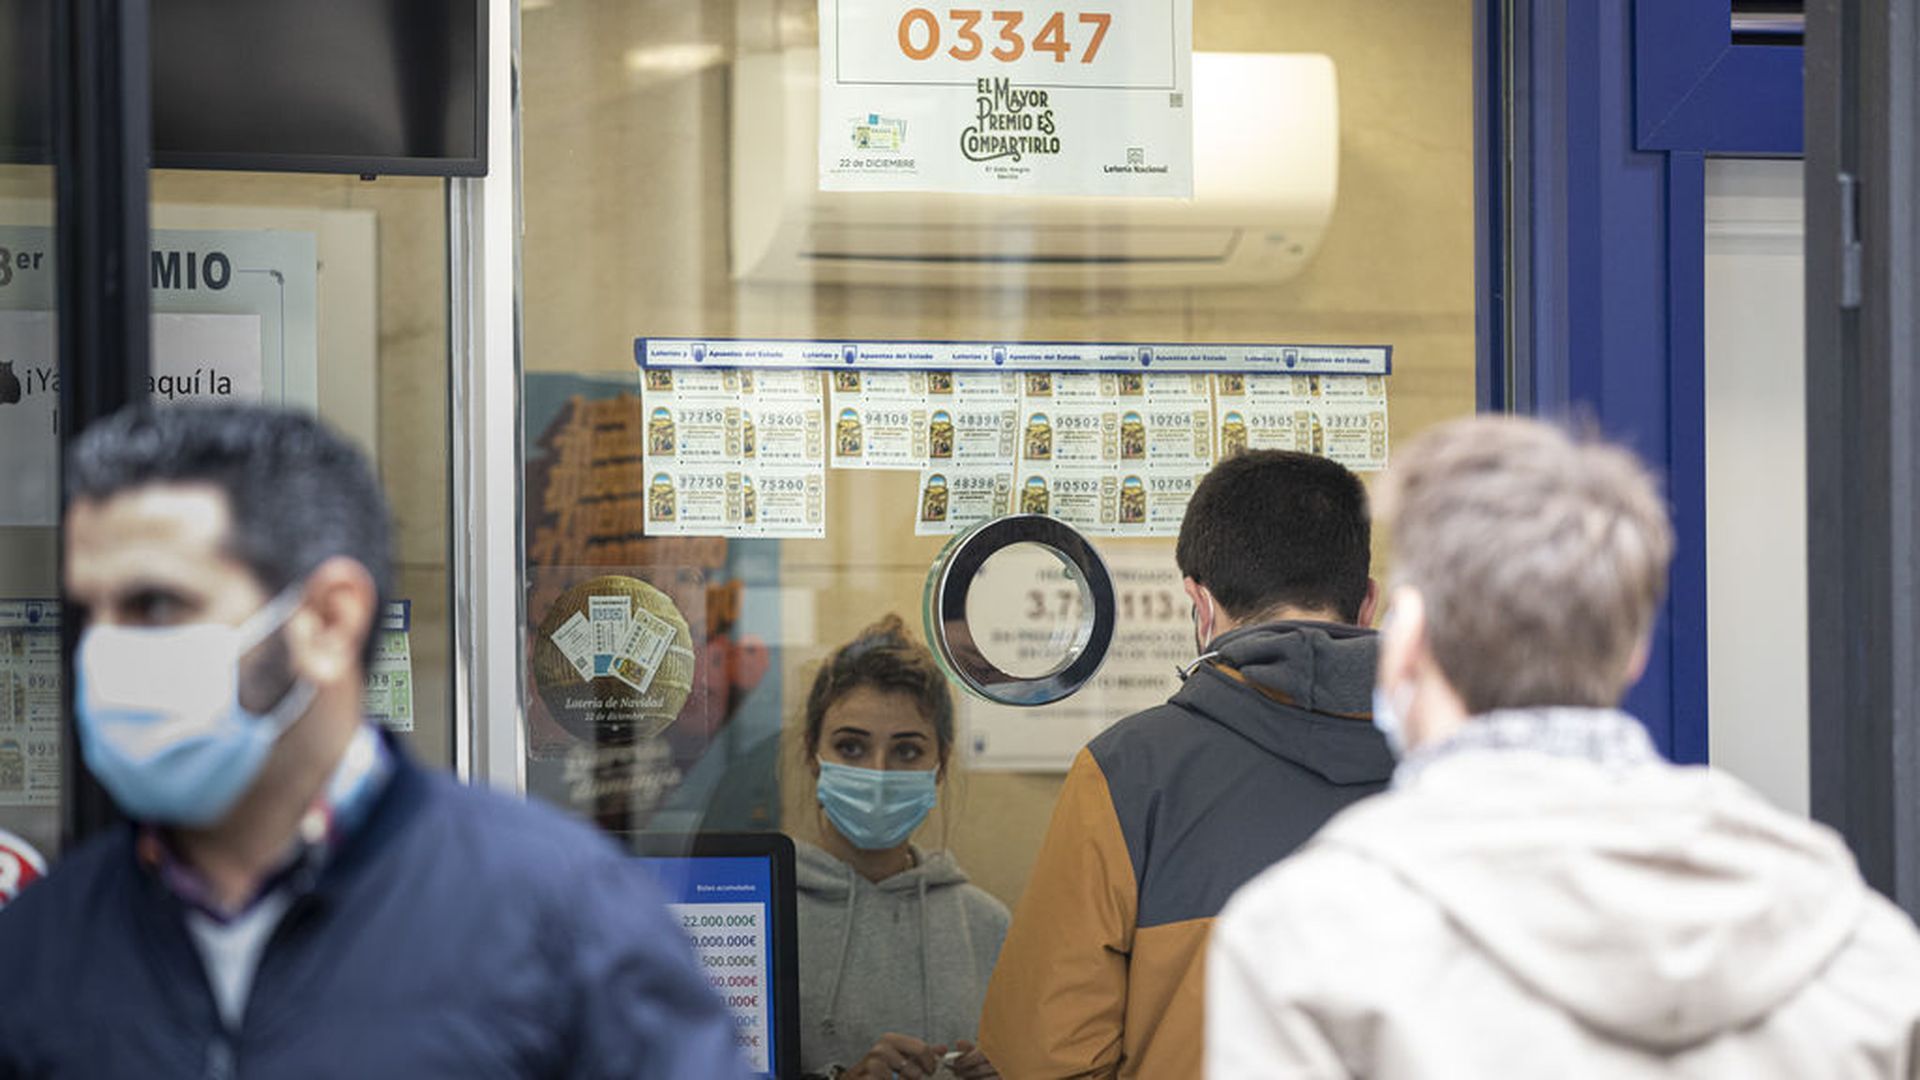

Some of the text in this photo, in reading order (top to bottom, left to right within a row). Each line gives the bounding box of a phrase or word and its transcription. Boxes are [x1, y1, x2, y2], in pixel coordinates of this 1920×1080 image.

[897, 8, 1112, 64] 03347
[977, 77, 1048, 113] EL MAYOR
[976, 97, 1055, 135] PREMIO ES
[960, 126, 1060, 162] COMPARTIRLO
[839, 158, 916, 169] 22 de DICIEMBRE
[150, 250, 232, 291] MIO
[1301, 356, 1332, 364] Apuestas
[146, 368, 202, 400] aquí
[209, 369, 232, 395] la
[678, 410, 723, 422] 37750
[759, 413, 803, 425] 75260
[865, 412, 908, 425] 94109
[1056, 416, 1099, 428] 90502
[1150, 414, 1191, 427] 10704
[1251, 415, 1293, 427] 61505
[679, 477, 723, 489] 37750
[759, 478, 804, 491] 75260
[954, 477, 994, 489] 48398
[1053, 480, 1099, 492] 90502
[1150, 478, 1192, 490] 10704
[605, 696, 618, 708] de
[620, 696, 665, 708] Navidad
[683, 914, 756, 928] 22.000.000€
[690, 935, 757, 947] 0.000.000€
[709, 975, 758, 988] 00.000€
